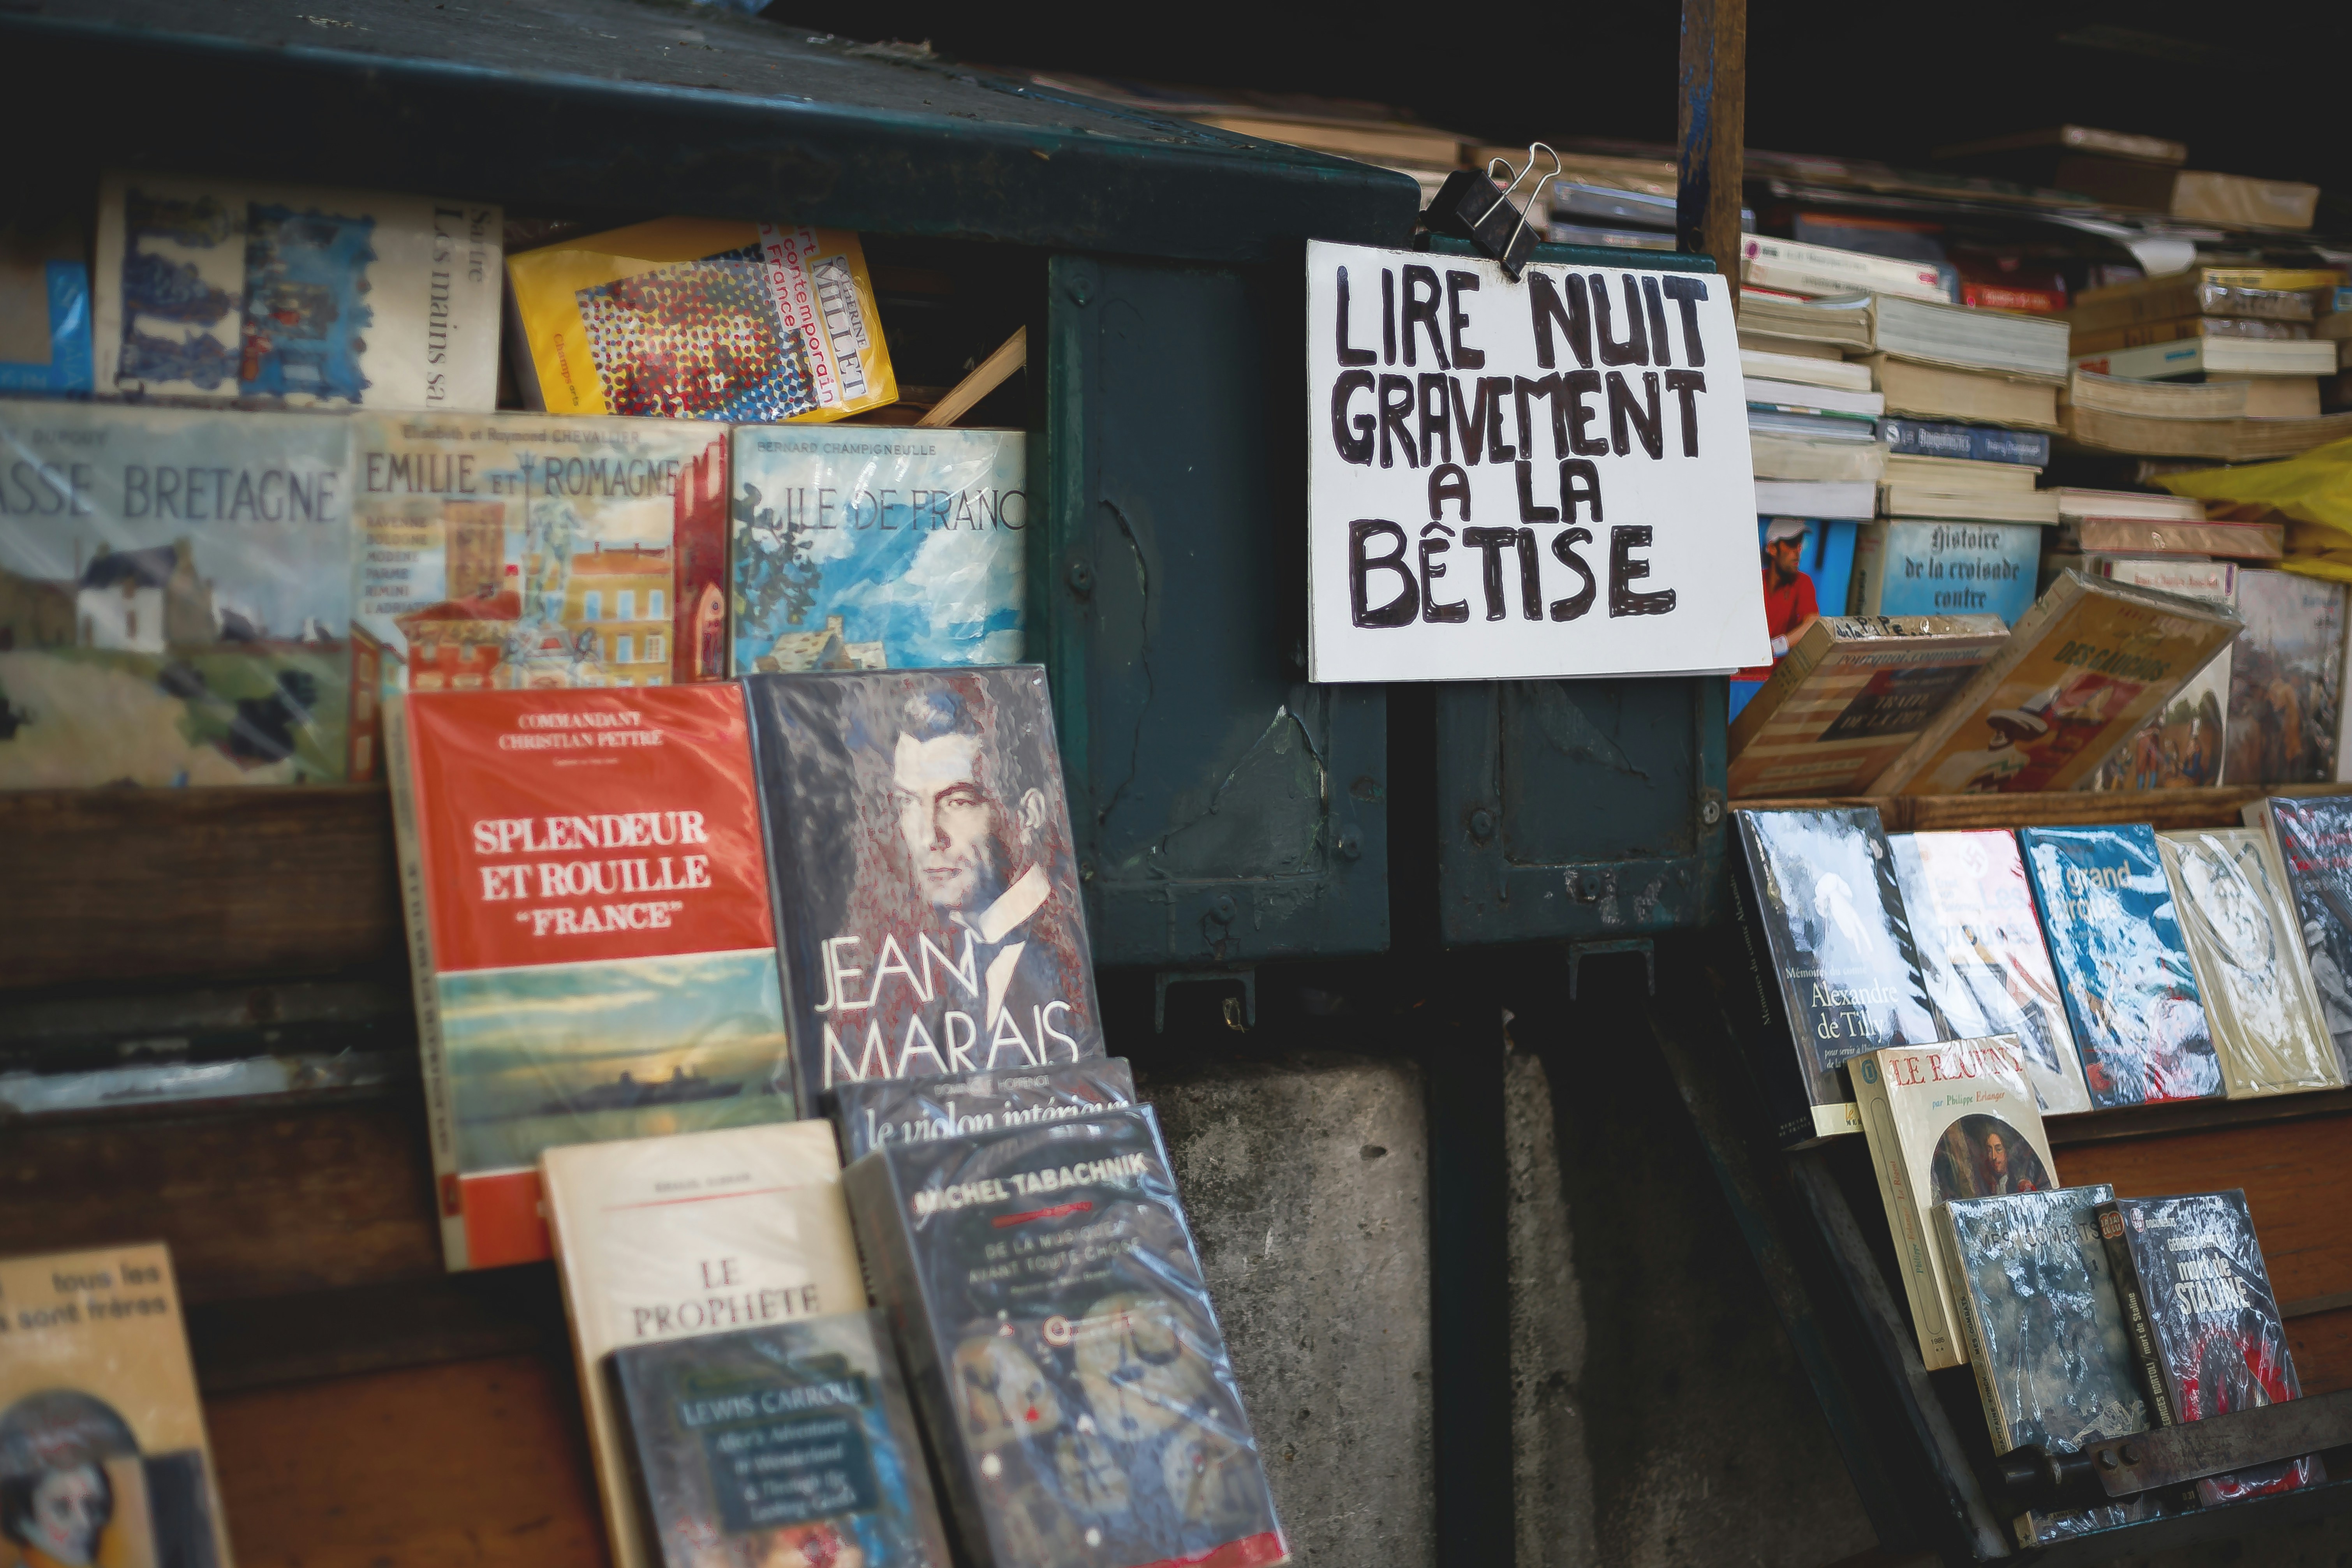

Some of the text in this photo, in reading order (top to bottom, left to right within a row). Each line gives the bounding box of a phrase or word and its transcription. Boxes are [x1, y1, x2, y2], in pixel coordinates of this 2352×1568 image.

[766, 243, 795, 327] France
[428, 272, 449, 364] mains
[783, 238, 835, 403] contemporain
[812, 258, 867, 395] MILLET
[1335, 264, 1709, 370] LIRE NUIT
[553, 333, 572, 384] Champs
[1330, 368, 1708, 469] GRAVEMENT
[758, 441, 937, 456] BERNARD CHAMPIGNEULLE
[124, 465, 338, 523] BRETAGNE
[366, 453, 680, 498] EMILIE ET ROMAGNE
[1427, 458, 1603, 524] A LA
[855, 488, 898, 530] DE
[1349, 519, 1676, 629] BÊTISE
[1904, 554, 2020, 581] de la croisade
[1934, 585, 1987, 610] contre
[473, 811, 710, 854] SPLENDEUR
[480, 855, 712, 902] ET ROUILLE
[2066, 859, 2133, 896] grand
[814, 929, 980, 1013] JEAN
[1811, 977, 1899, 1008] Alexandre
[823, 1000, 1080, 1091] MARAIS
[1817, 1012, 1841, 1039] de
[1889, 1056, 1926, 1087] LE
[1932, 1091, 2006, 1110] par Philippe Erlanger
[865, 1108, 895, 1151] le
[900, 1100, 994, 1145] violon
[913, 1152, 1149, 1215] MICHEL TABACHNIK
[700, 1258, 740, 1289] LE
[2213, 1251, 2232, 1277] de
[2127, 1292, 2142, 1321] Staline
[2175, 1276, 2251, 1315] STALINE
[2135, 1322, 2145, 1332] de
[2139, 1334, 2152, 1355] mort
[2146, 1362, 2163, 1395] BORTOLI
